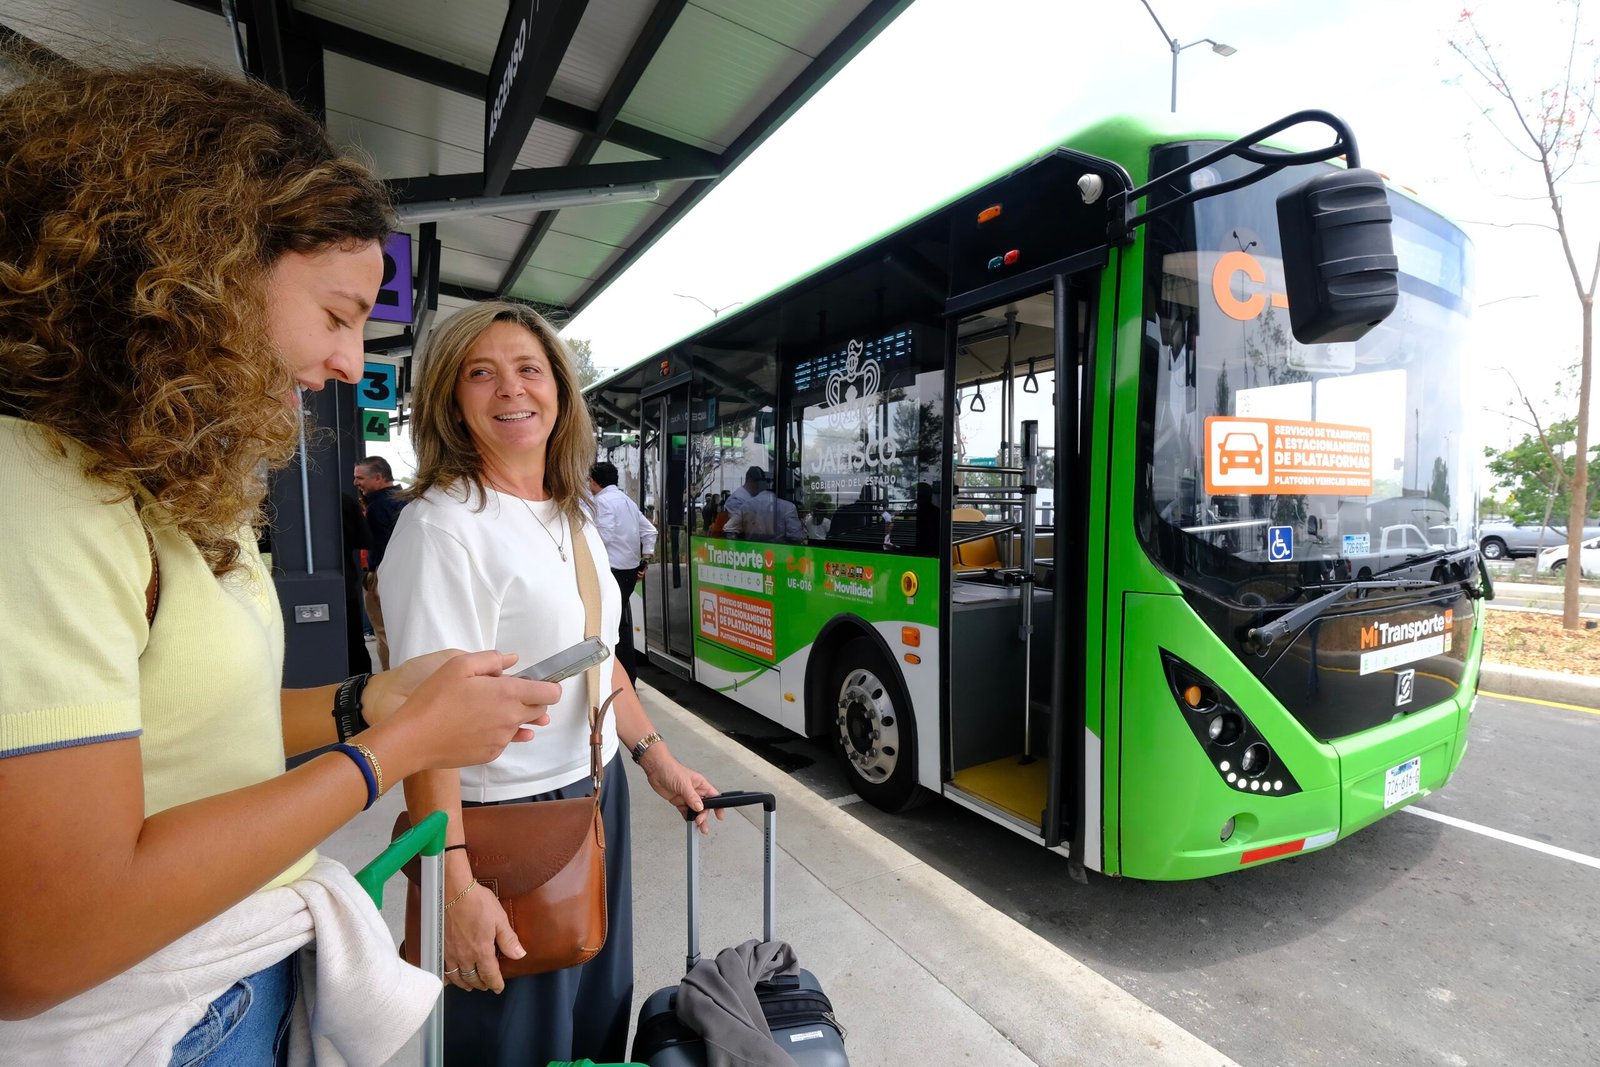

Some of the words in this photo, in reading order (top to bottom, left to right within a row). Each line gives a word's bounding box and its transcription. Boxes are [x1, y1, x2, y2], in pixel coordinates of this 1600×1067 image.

[489, 18, 527, 146] ASCENSO
[363, 371, 390, 401] 3
[366, 416, 387, 436] 4
[1274, 425, 1314, 437] SERVICIO
[1315, 428, 1325, 437] DE
[1326, 428, 1370, 442] TRANSPORTE
[811, 436, 899, 473] JALISCO
[1275, 438, 1283, 449] A
[1285, 437, 1370, 455] ESTACIONAMIENTO
[1274, 452, 1291, 465] DE
[1293, 452, 1370, 470] PLATAFORMAS
[811, 479, 846, 490] GOBIERNO
[848, 477, 862, 487] DEL
[865, 475, 896, 486] ESTADO
[1274, 475, 1314, 485] PLATFORM
[708, 545, 763, 572] Transporte
[787, 577, 812, 591] UE-016
[834, 579, 873, 598] Movilidad
[724, 606, 772, 627] ESTACIONAMIENTO
[720, 615, 727, 625] DE
[728, 616, 772, 641] PLATAFORMAS
[1361, 621, 1378, 650] Mi
[1379, 613, 1445, 645] Transporte
